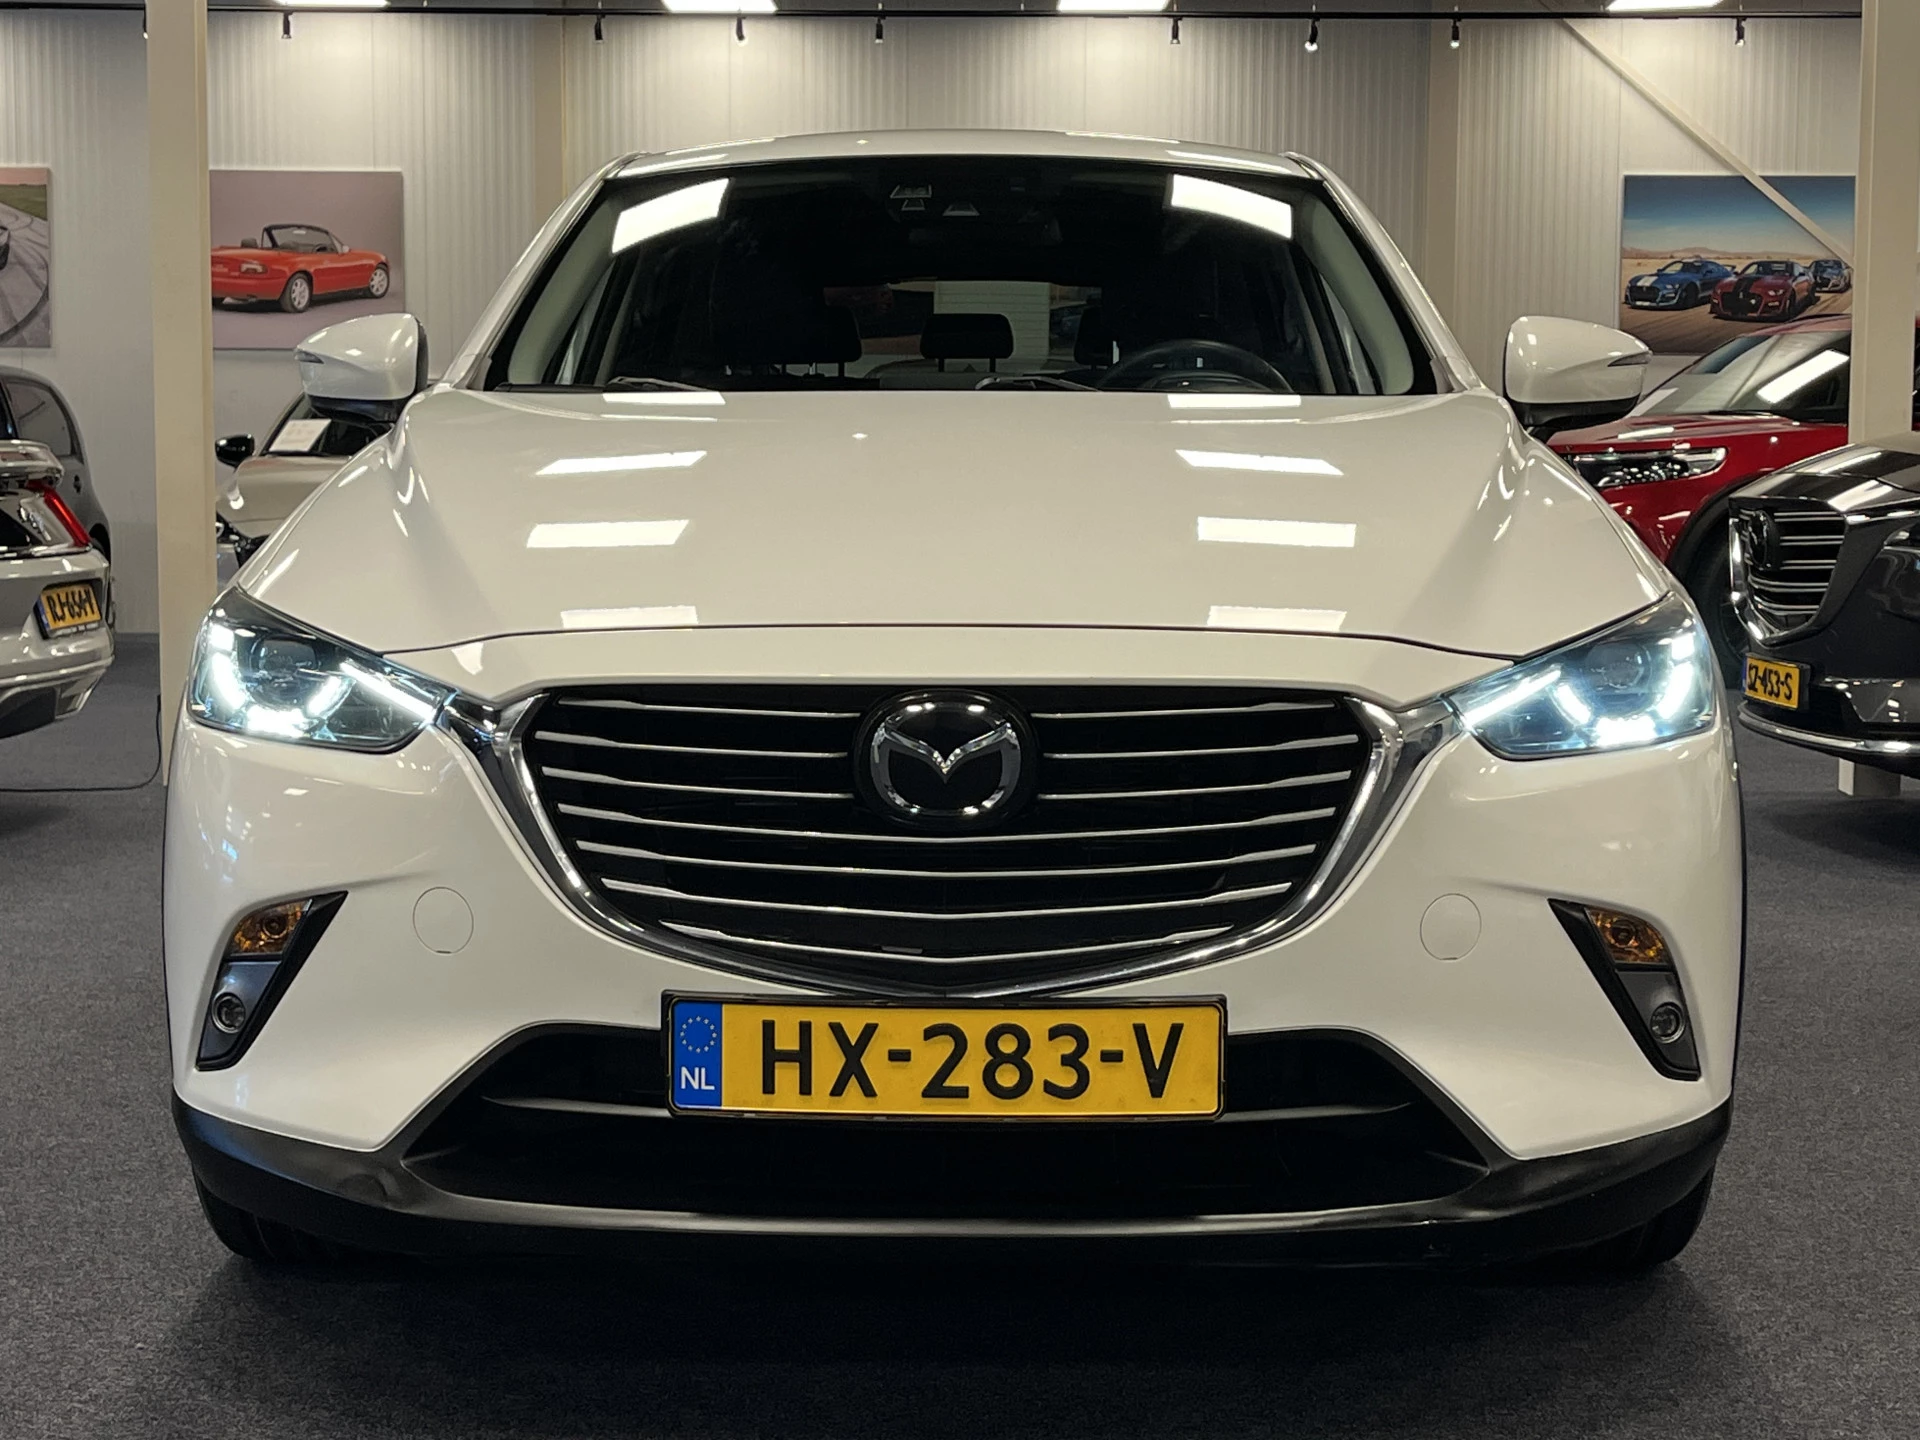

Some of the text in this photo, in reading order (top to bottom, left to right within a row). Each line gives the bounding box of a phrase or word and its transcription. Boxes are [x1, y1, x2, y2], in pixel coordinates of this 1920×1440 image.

[1747, 663, 1793, 700] SZ-453-S
[762, 1019, 1184, 1100] HX-283-V
[680, 1066, 715, 1091] NL
